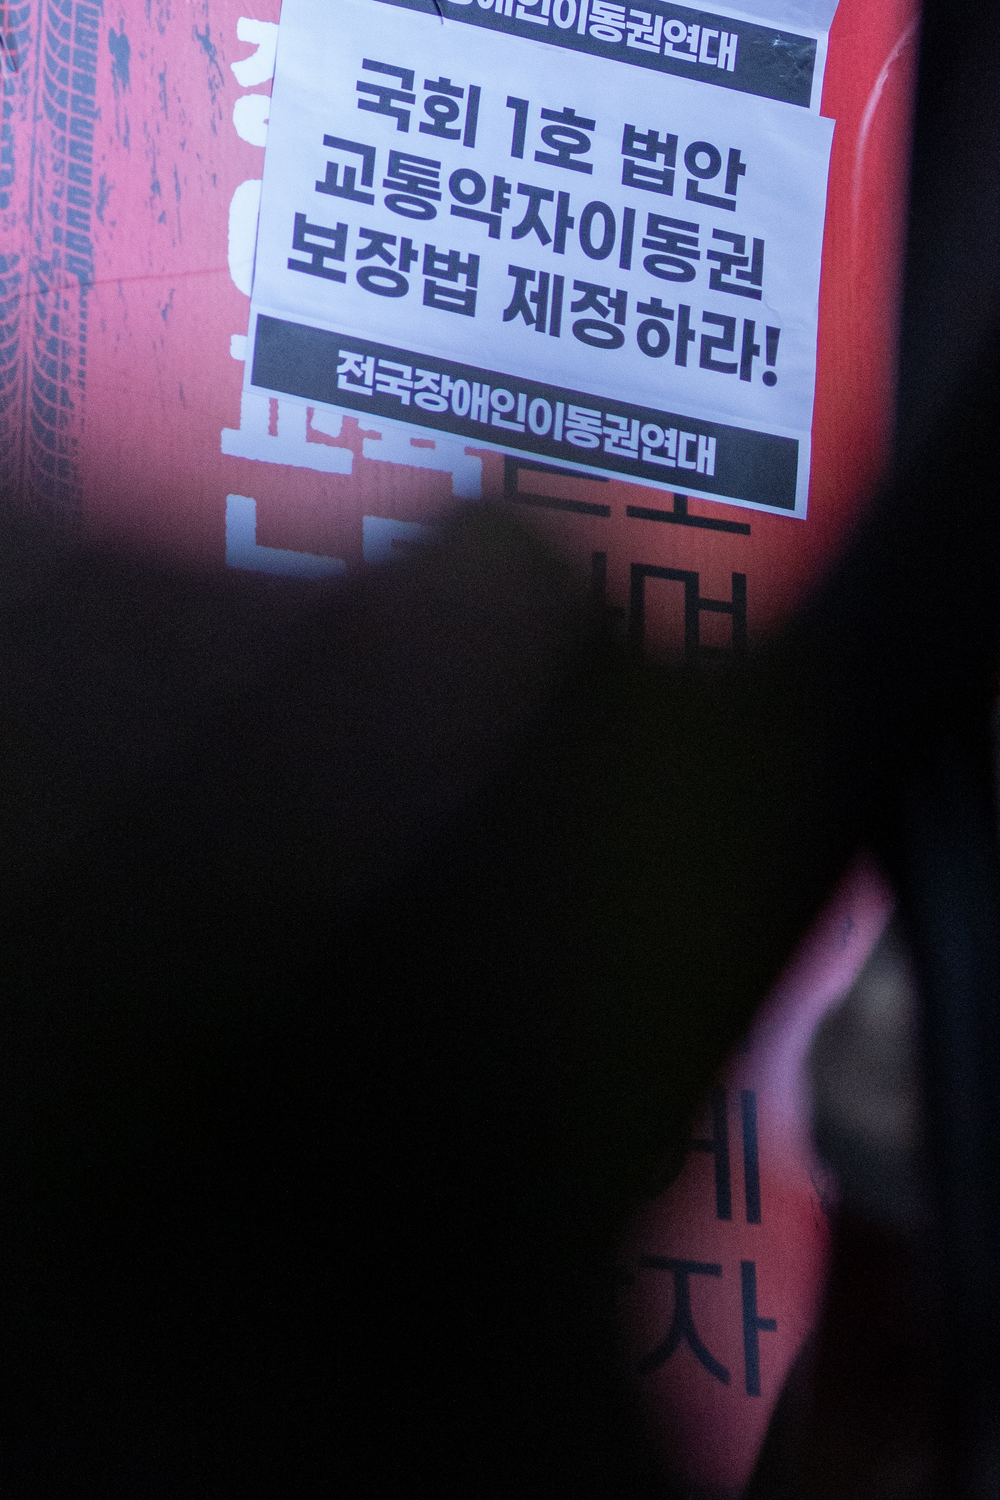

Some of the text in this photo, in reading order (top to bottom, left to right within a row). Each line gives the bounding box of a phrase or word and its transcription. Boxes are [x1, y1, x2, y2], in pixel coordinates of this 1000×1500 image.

[354, 57, 748, 213] 국회 1호 법안
[314, 133, 767, 302] 교통약자이동권
[287, 211, 783, 388] 보장법 제정하라!
[336, 349, 719, 479] 전국장애인이동권연대
